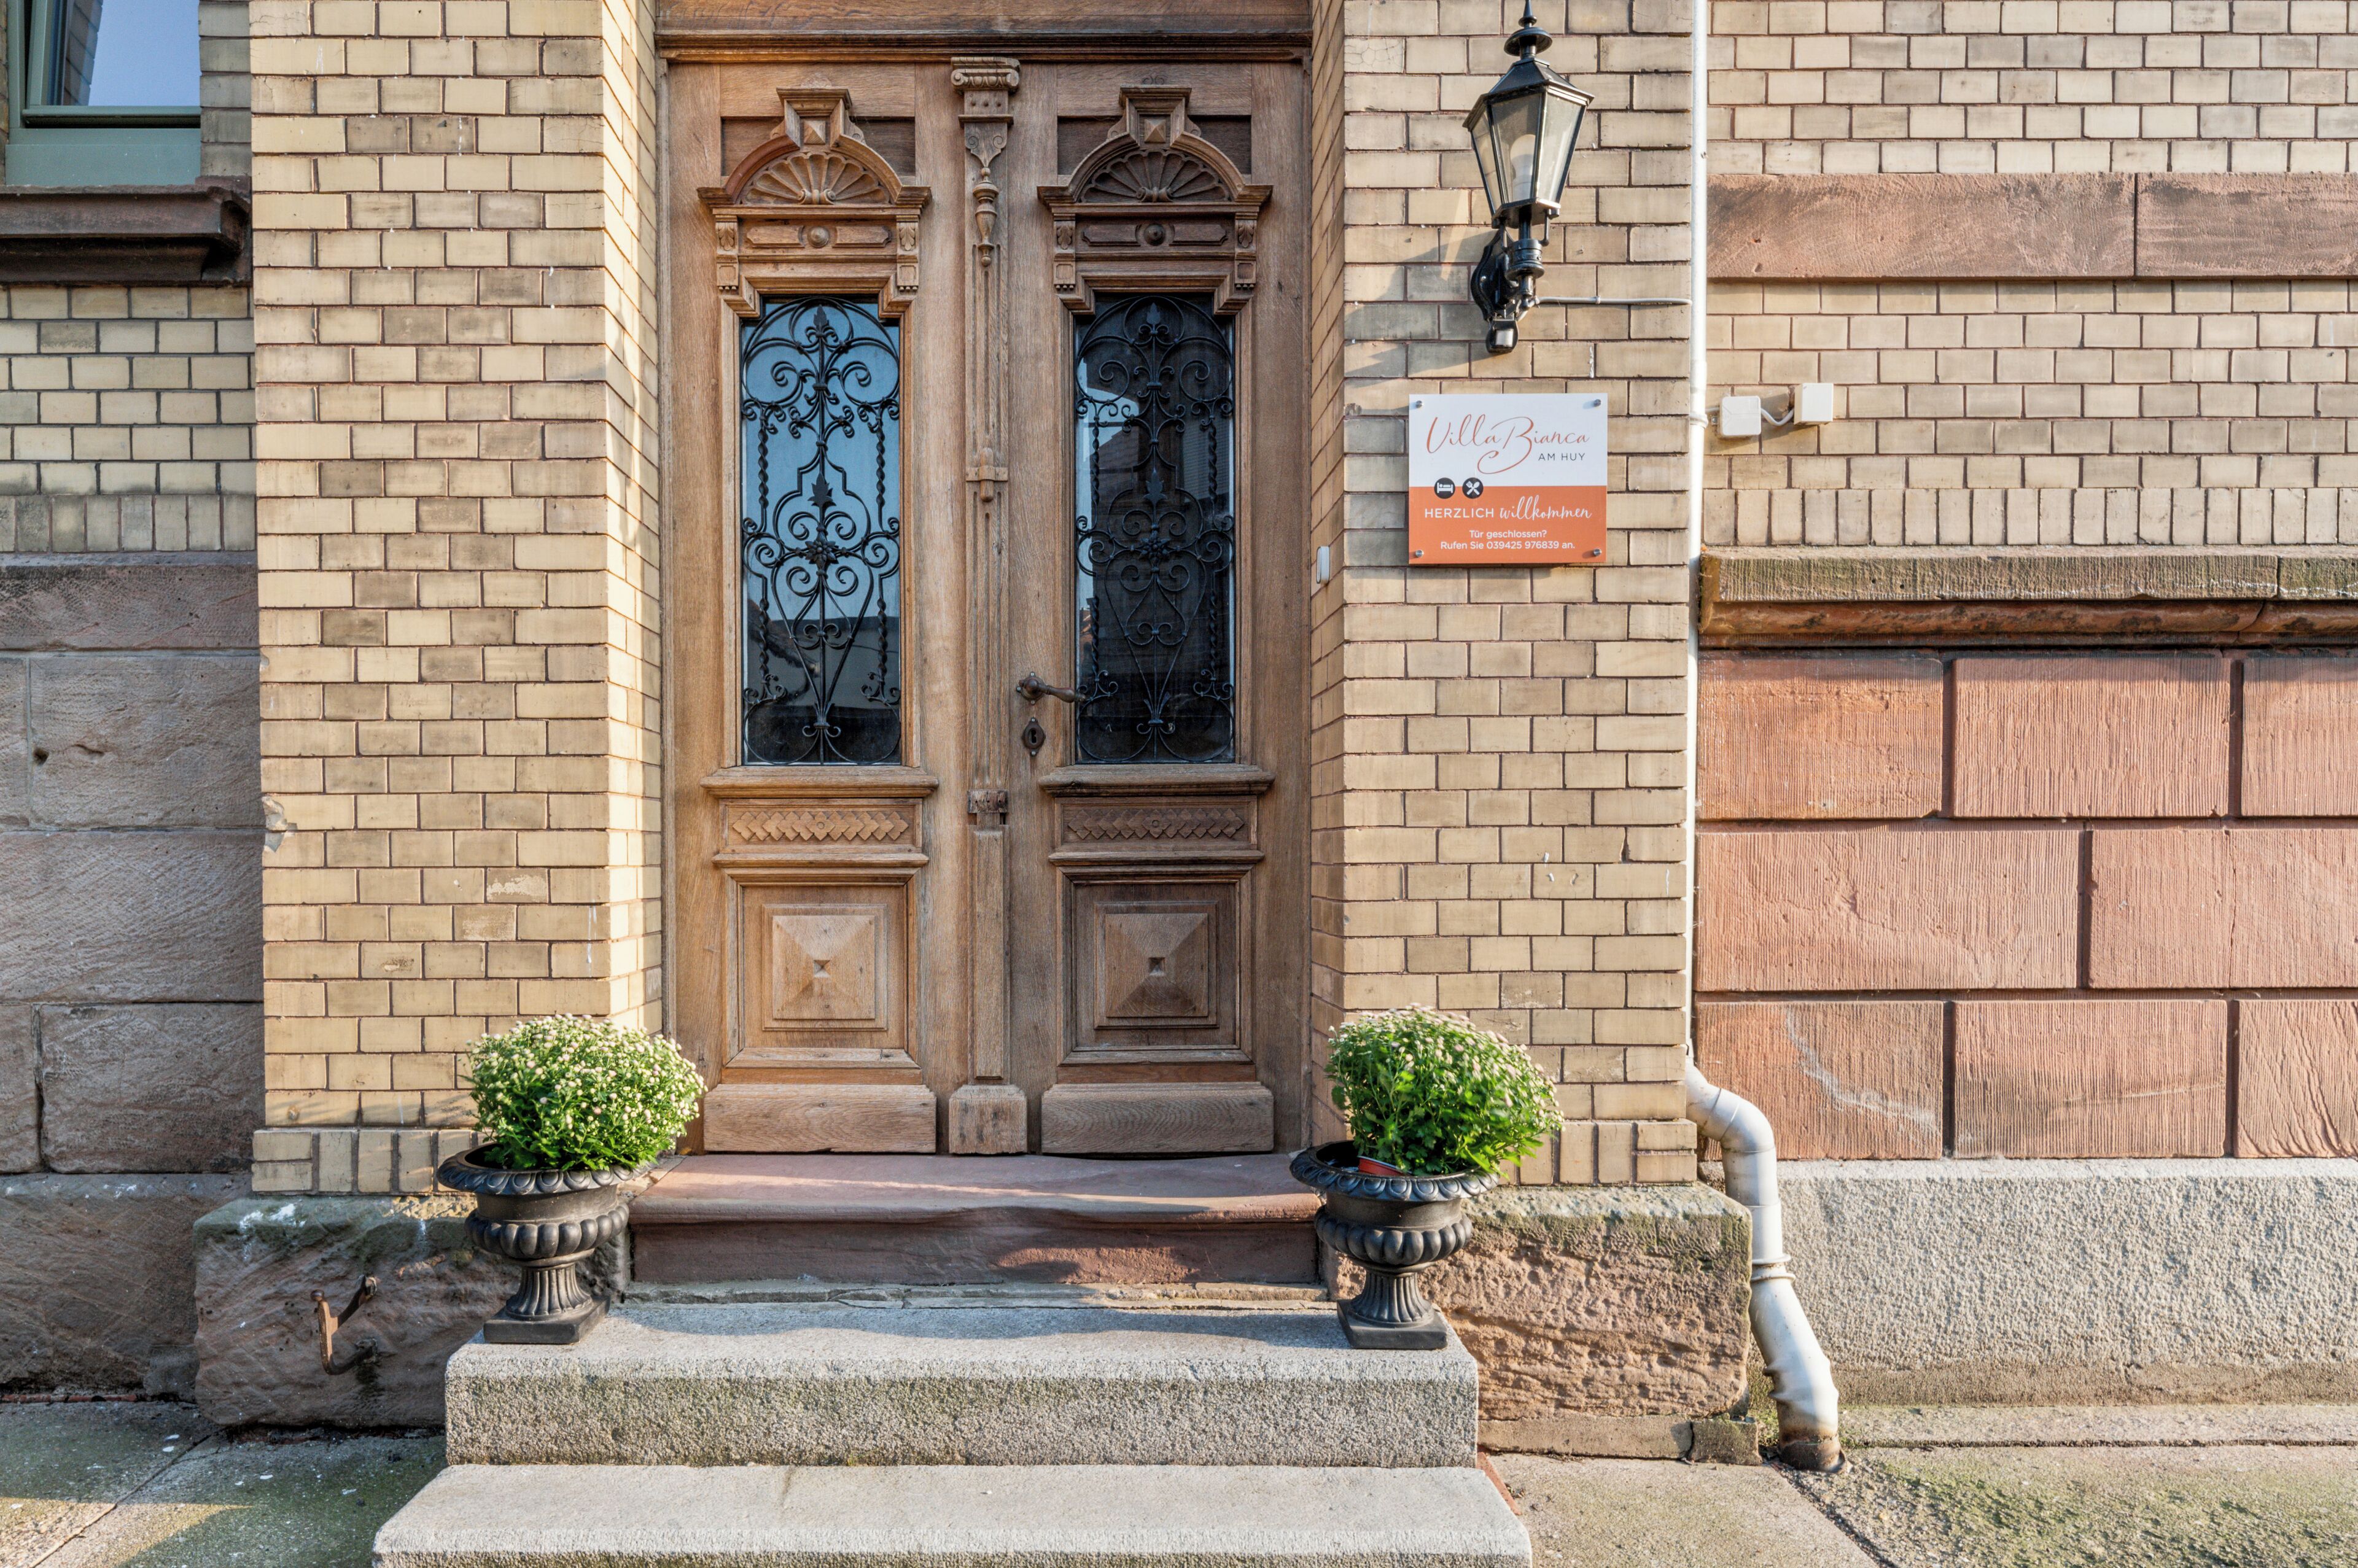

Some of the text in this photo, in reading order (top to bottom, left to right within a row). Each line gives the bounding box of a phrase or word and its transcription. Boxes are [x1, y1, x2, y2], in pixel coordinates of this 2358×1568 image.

[1426, 414, 1590, 474] Villa Bianca
[1425, 495, 1592, 521] HERZLICH willkommen
[1487, 530, 1547, 540] geschlossen?
